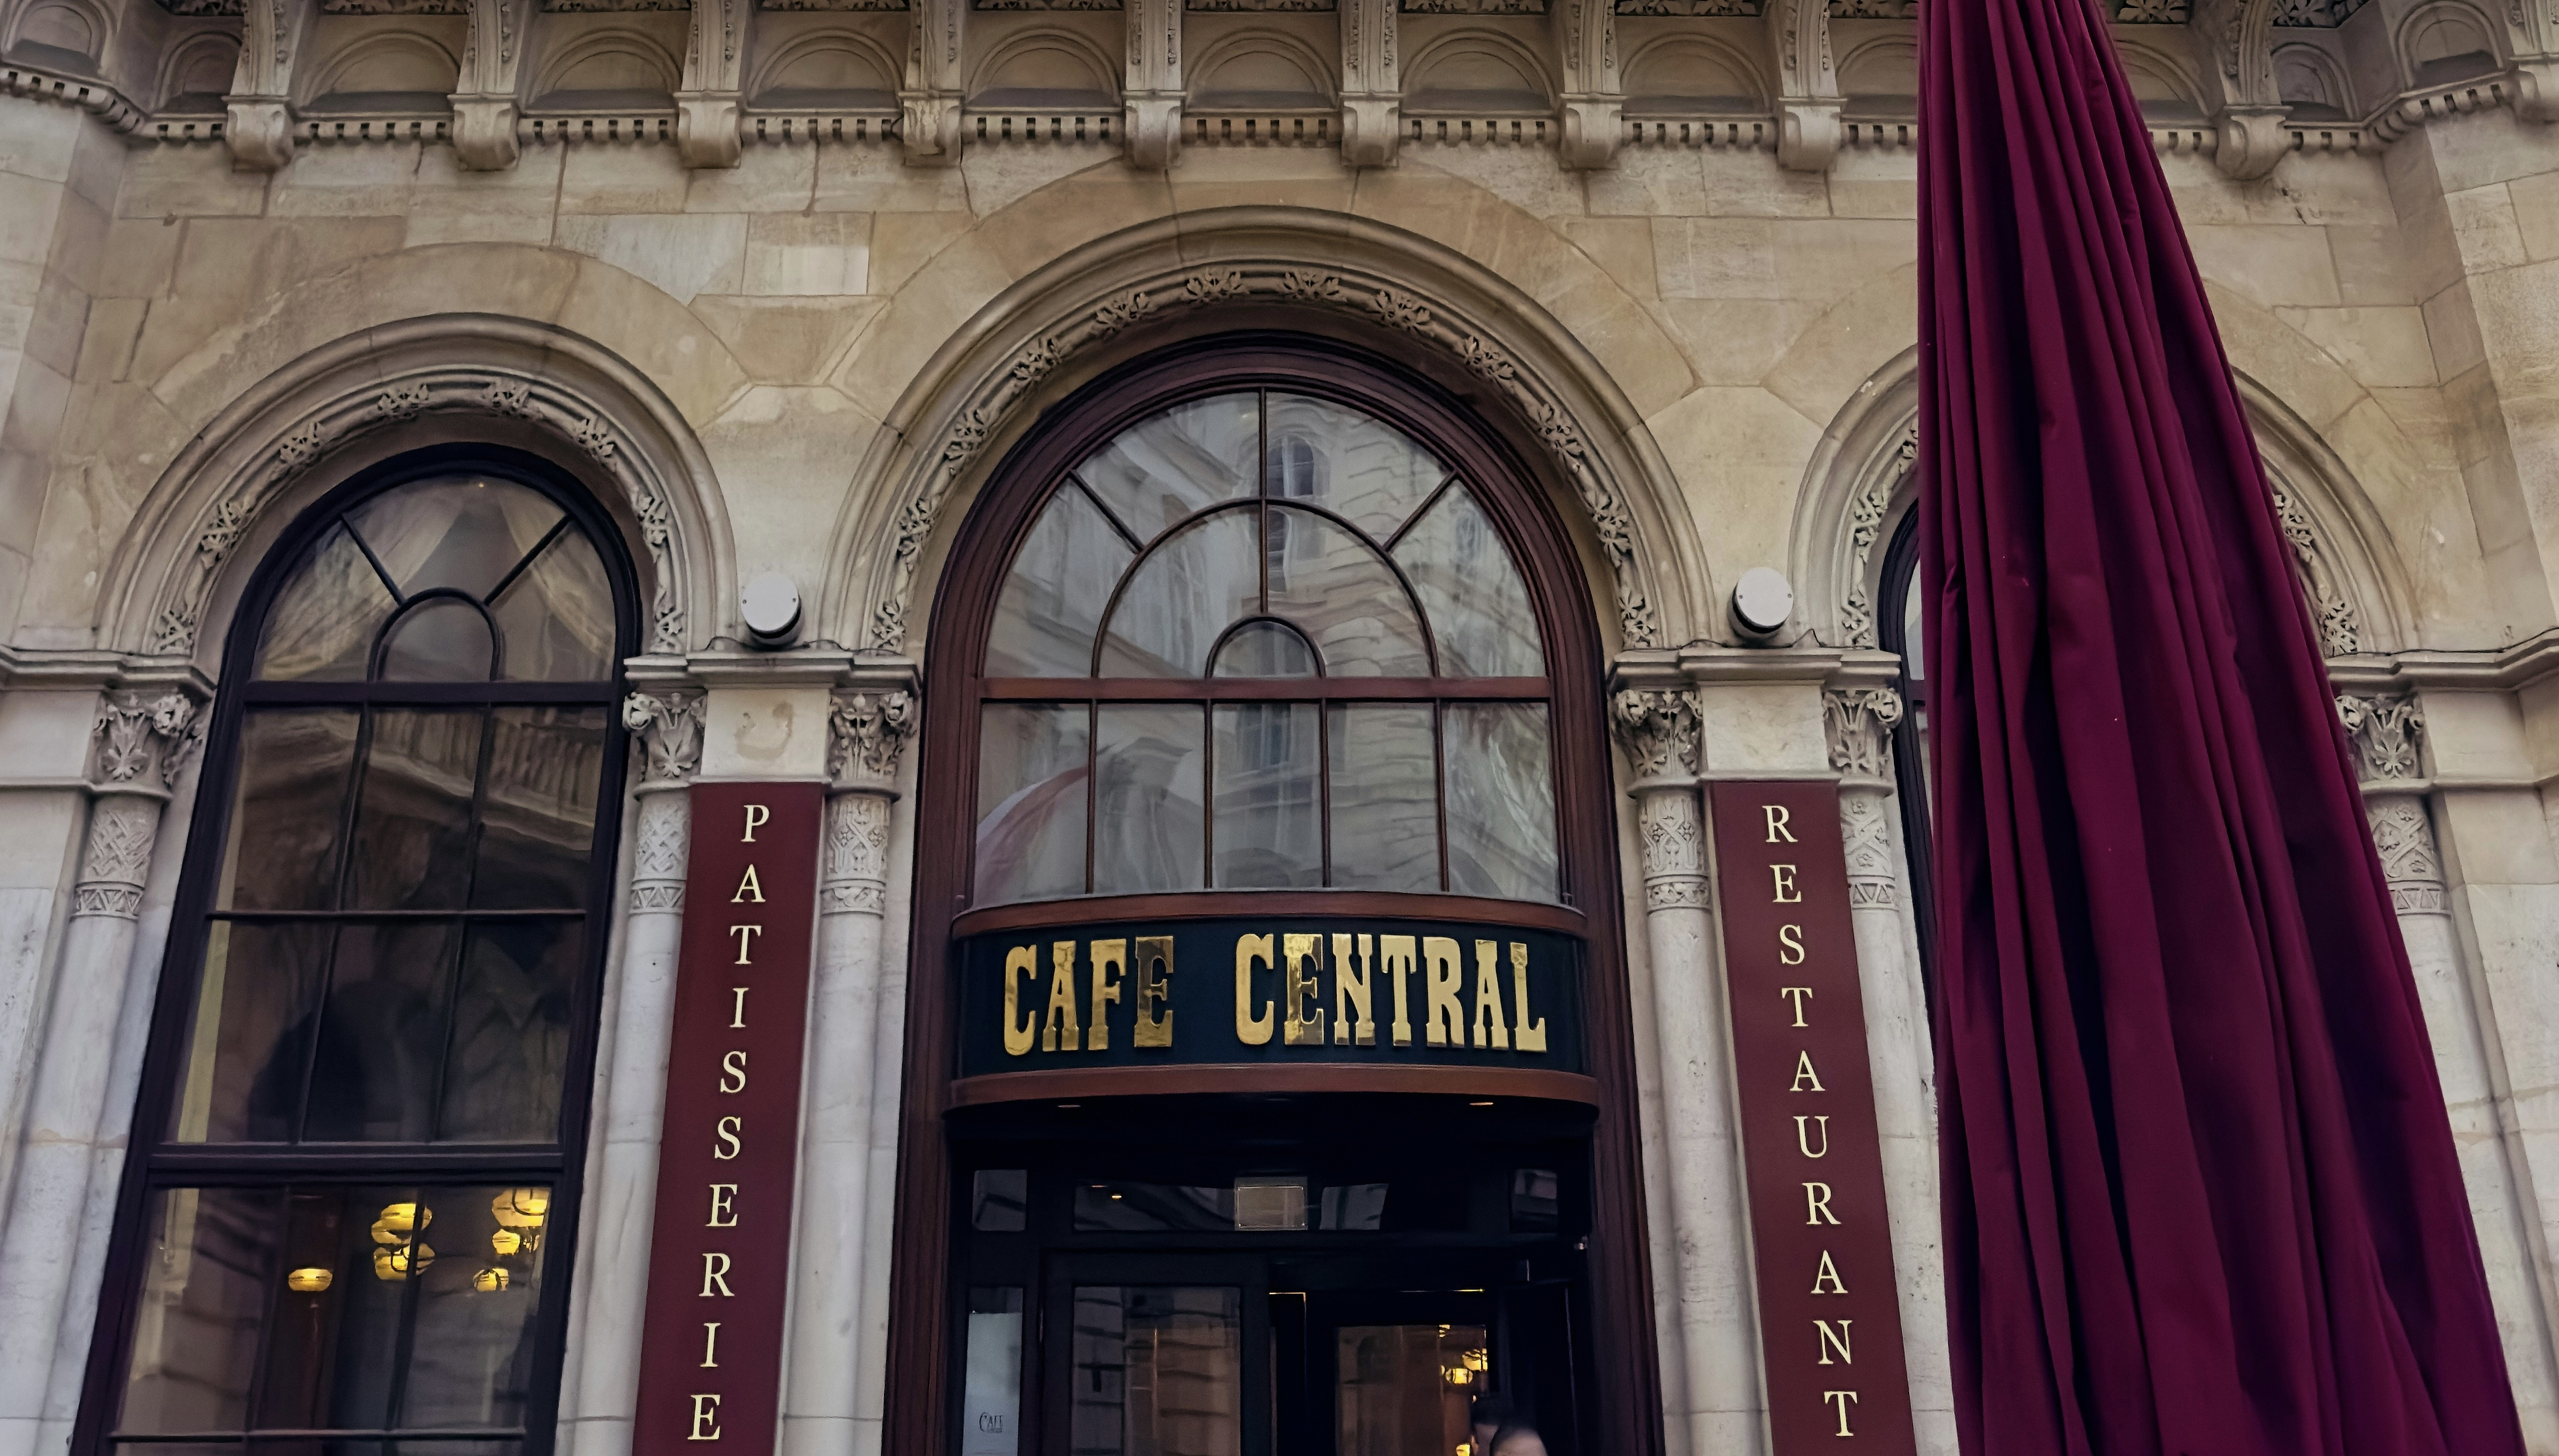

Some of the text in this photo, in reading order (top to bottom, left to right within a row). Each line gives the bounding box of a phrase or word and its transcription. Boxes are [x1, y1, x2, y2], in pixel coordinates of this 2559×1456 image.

[687, 804, 770, 1440] PATISSERIE
[1004, 933, 1547, 1056] CAFE CENTRAL
[1762, 805, 1858, 1437] RESTAURANT
